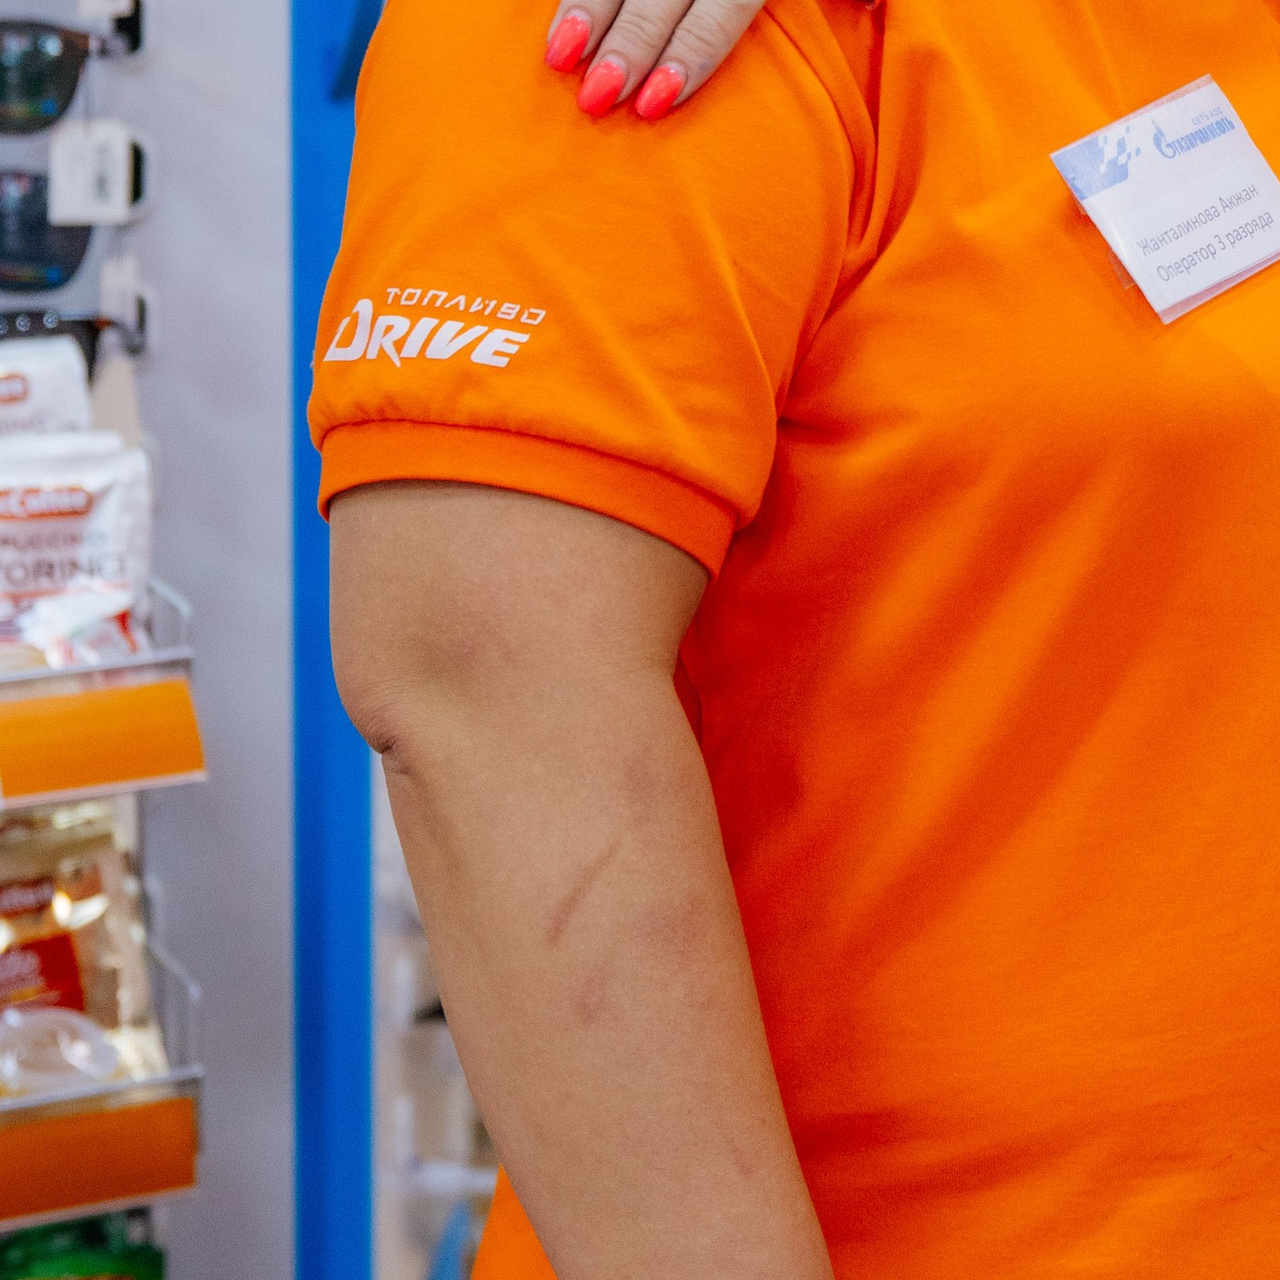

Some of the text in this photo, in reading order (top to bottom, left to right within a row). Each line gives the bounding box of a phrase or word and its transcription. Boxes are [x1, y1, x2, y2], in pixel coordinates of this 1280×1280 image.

[1137, 184, 1260, 257] Жанталинова Акжан
[1156, 210, 1275, 282] Оператор 3 разряда
[323, 298, 531, 368] DRIVE
[386, 287, 547, 326] ТОПЛИВО
